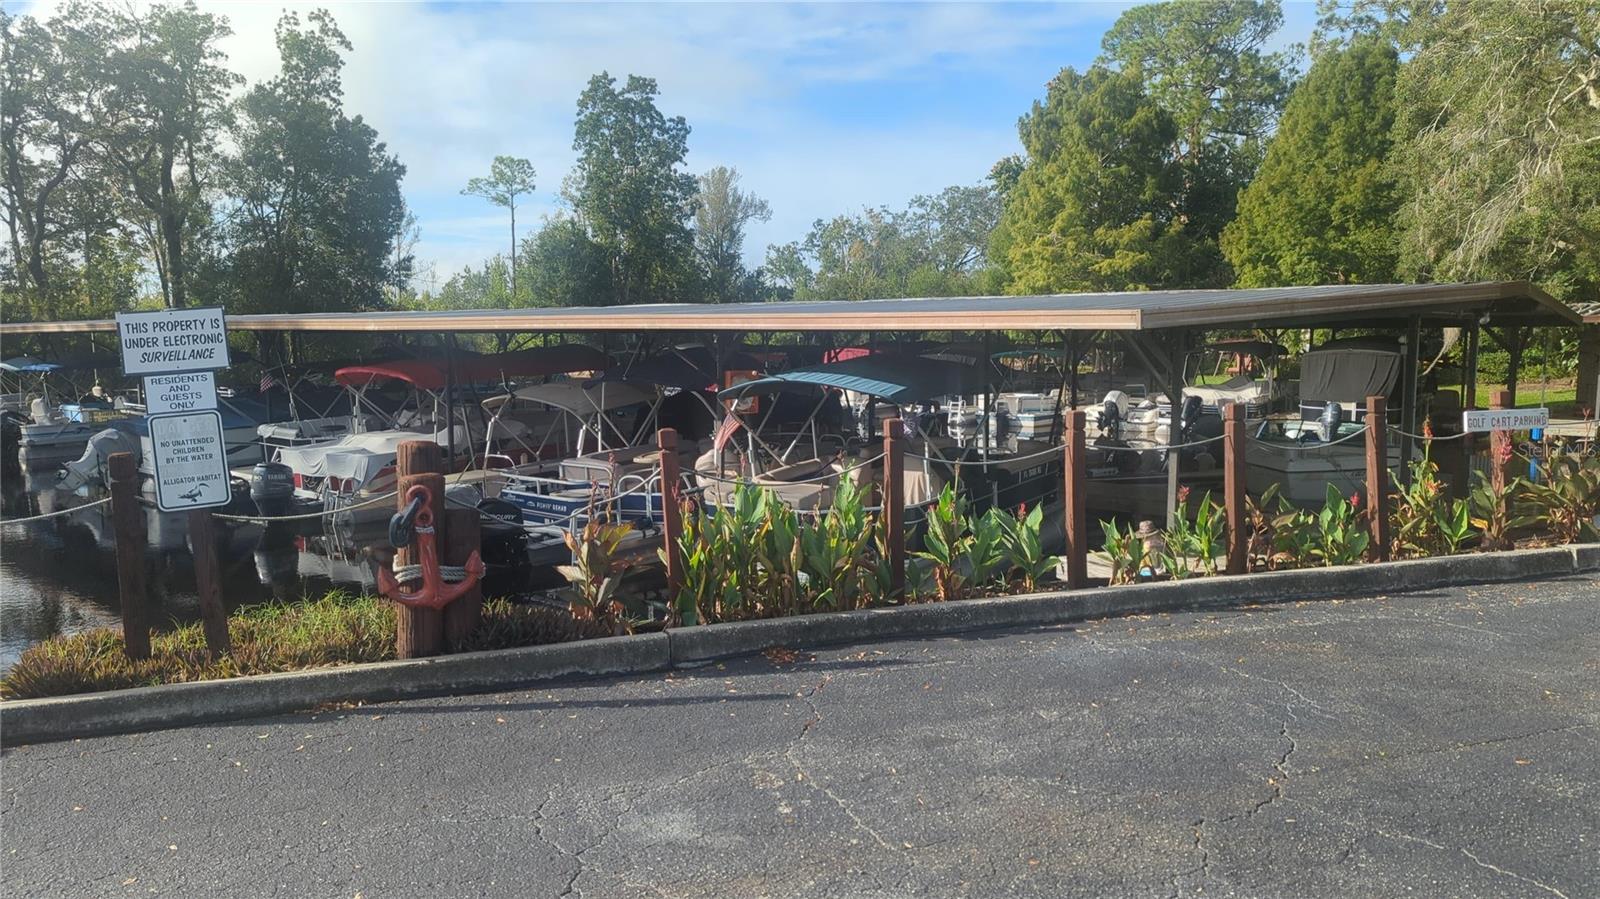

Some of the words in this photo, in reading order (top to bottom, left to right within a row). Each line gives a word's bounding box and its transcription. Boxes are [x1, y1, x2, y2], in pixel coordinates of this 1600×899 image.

[125, 322, 148, 334] THIS
[152, 318, 206, 333] PROPERTY
[210, 318, 220, 329] IS
[125, 337, 159, 349] UNDER
[163, 332, 223, 347] ELECTRONIC
[140, 348, 215, 363] SURVEILLANCE
[150, 374, 208, 385] RESIDENTS
[169, 384, 191, 393] AND
[160, 392, 202, 402] GUESTS
[169, 401, 195, 410] ONLY
[1467, 417, 1486, 428] GOLF
[1491, 415, 1511, 427] CART
[1514, 415, 1547, 426] PARKING
[160, 440, 170, 448] NO
[172, 437, 214, 447] UNATTENDED
[172, 446, 205, 455] CHILDREN
[176, 455, 190, 463] THE
[191, 453, 213, 461] WATER
[163, 476, 196, 486] ALLIGATOR
[196, 473, 221, 482] HABITAT
